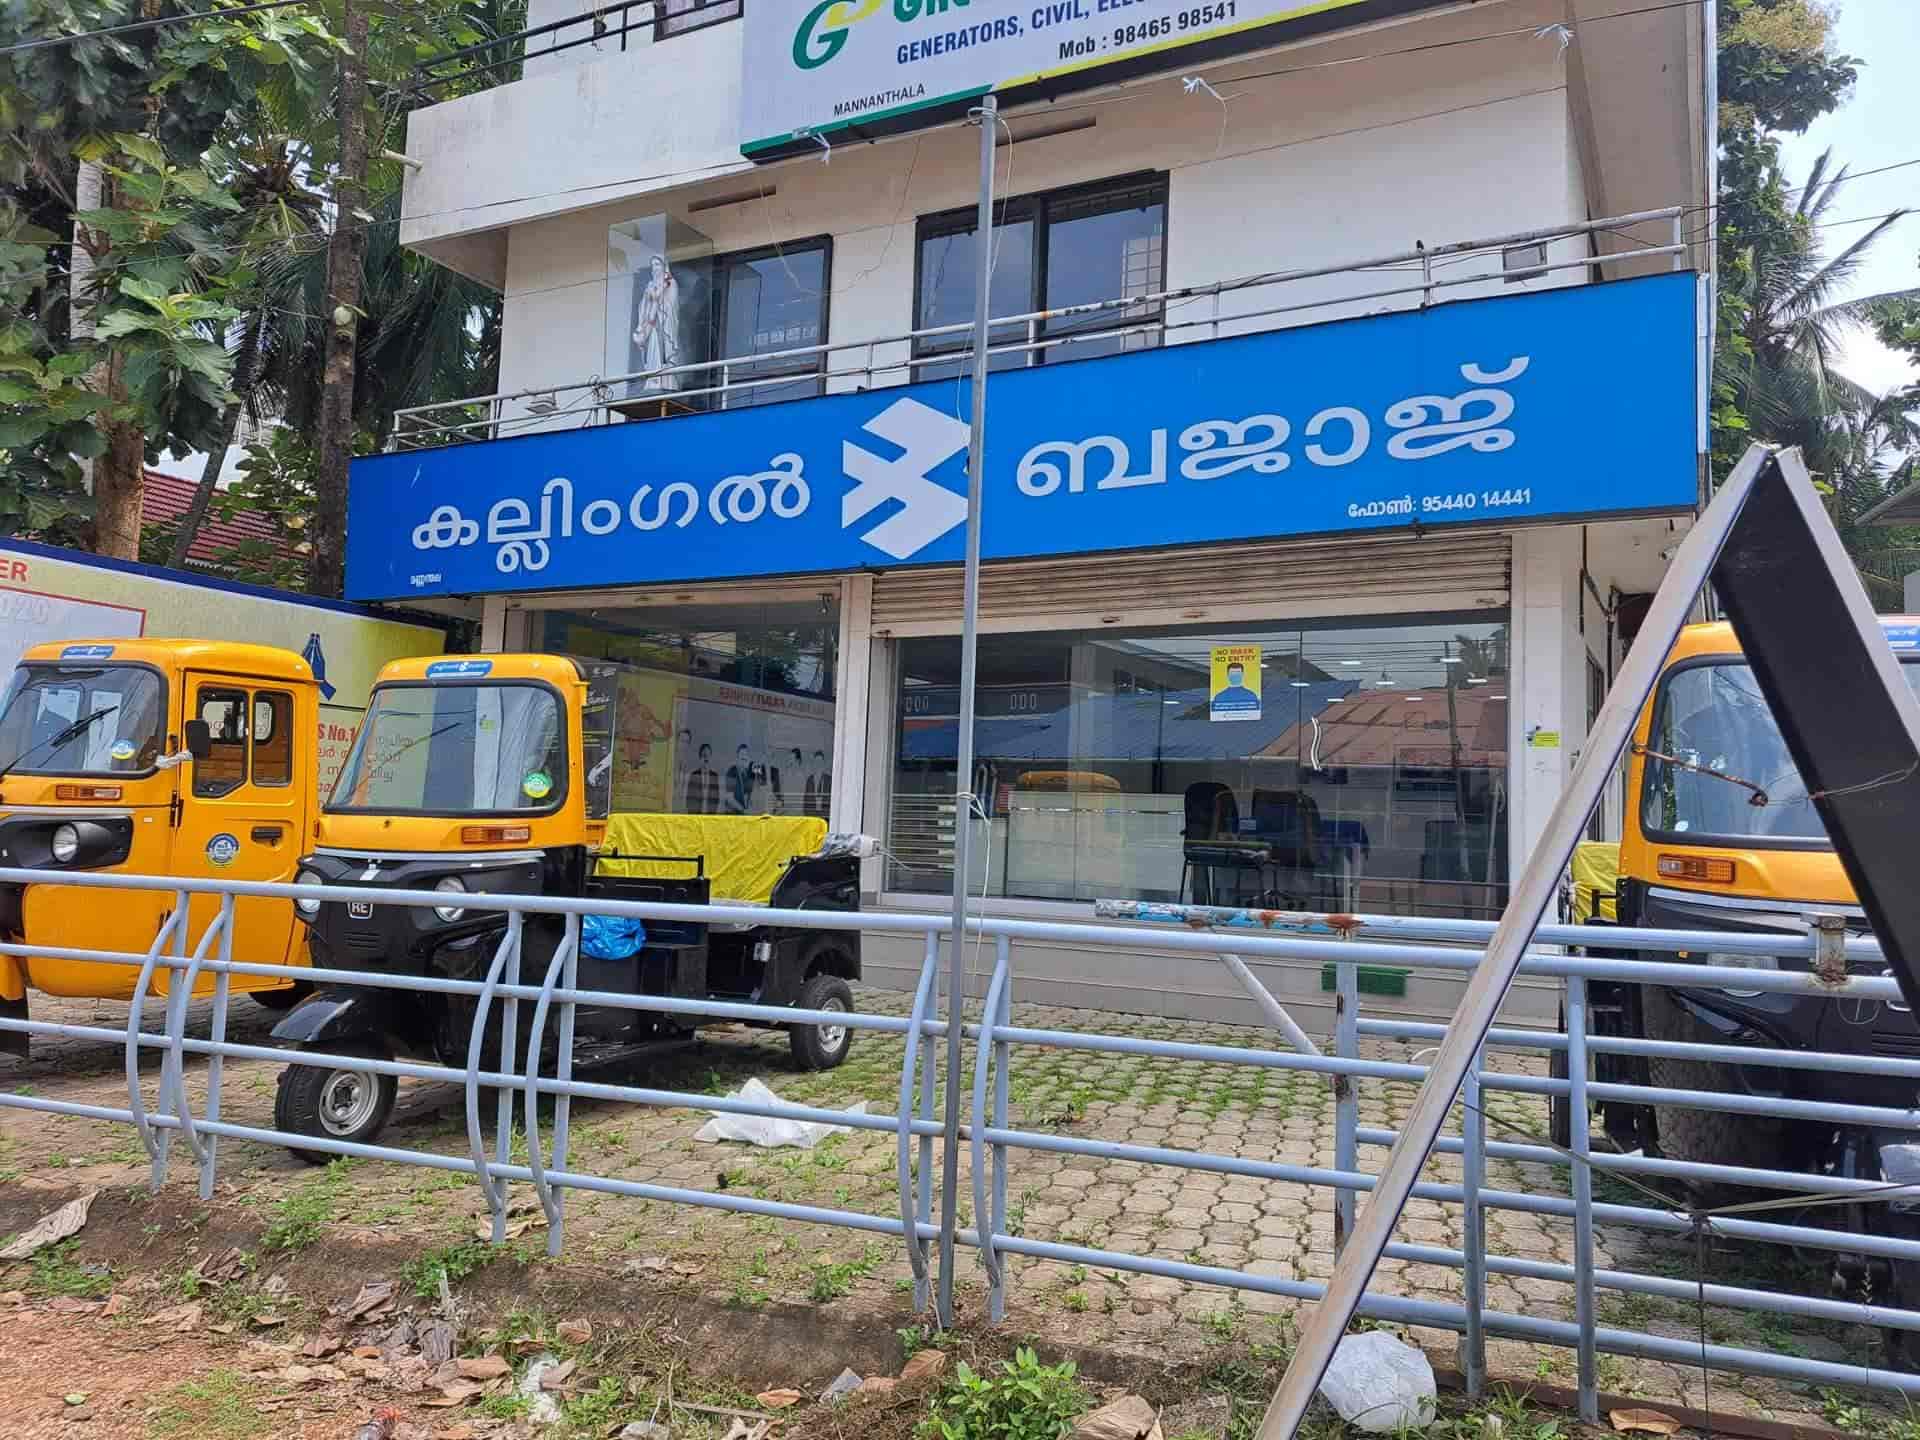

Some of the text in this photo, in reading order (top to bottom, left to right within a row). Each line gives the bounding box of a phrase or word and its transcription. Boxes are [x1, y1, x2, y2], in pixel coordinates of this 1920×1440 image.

[896, 0, 1090, 64] GENERATORS, CIVIL,
[1059, 36, 1096, 59] Mob
[1114, 17, 1171, 46] 98465
[1178, 1, 1236, 30] 98541
[833, 83, 926, 115] MANNANTHALA
[412, 356, 1530, 572] കല്ലിംഗൽ ബജാജ്
[1422, 493, 1475, 512] 95440
[1481, 487, 1532, 507] 14441
